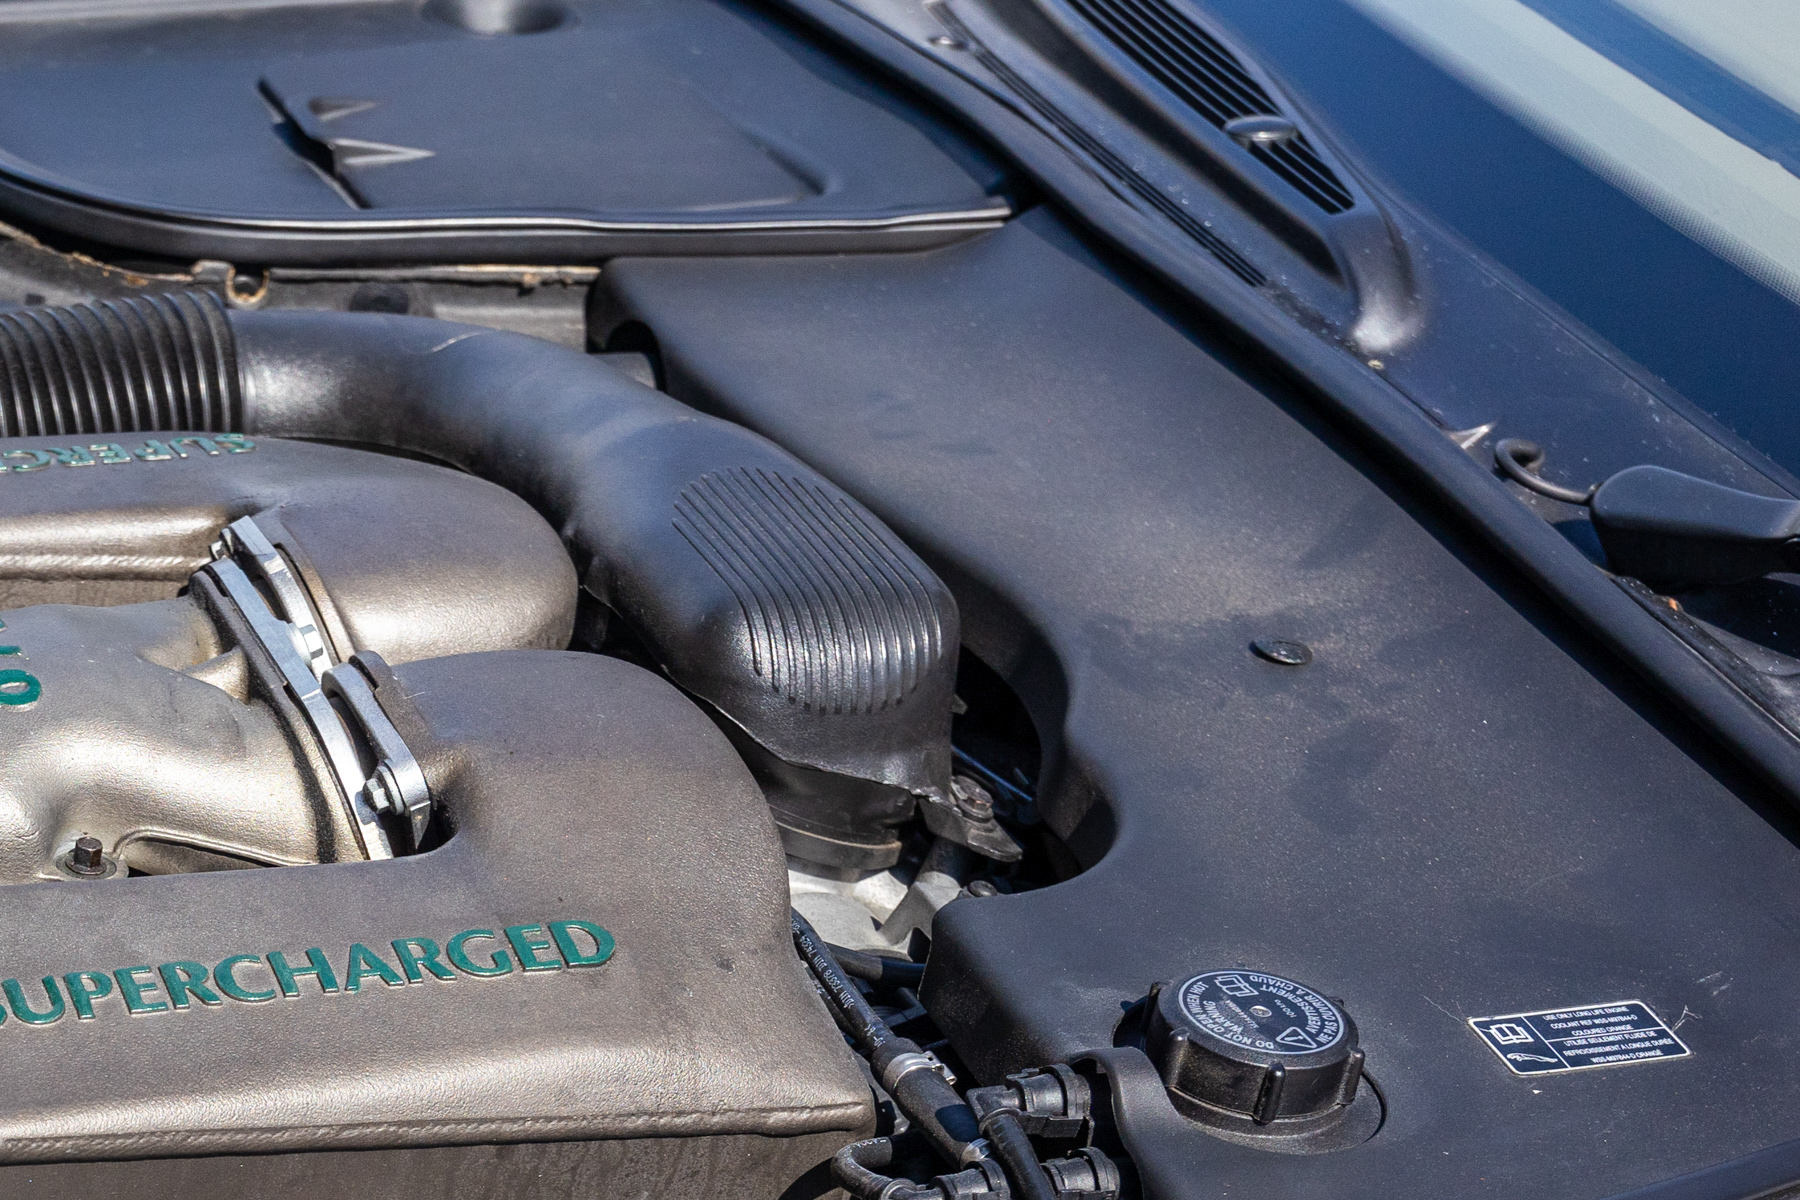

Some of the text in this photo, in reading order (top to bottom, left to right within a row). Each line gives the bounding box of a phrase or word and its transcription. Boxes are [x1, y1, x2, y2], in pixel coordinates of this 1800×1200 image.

[1250, 975, 1294, 991] CHAUD
[1187, 981, 1274, 1050] DO NOT OPEN WHEN HOT
[1260, 985, 1321, 1034] AVERTISSEMENT
[1305, 994, 1335, 1021] OUVRIR
[1542, 1013, 1556, 1021] USE
[1556, 1011, 1573, 1019] ONLY
[1573, 1009, 1592, 1018] LONG
[1202, 1001, 1244, 1034] WARNING
[1550, 1020, 1581, 1030] COOLANT
[1325, 1020, 1338, 1036] PAS
[1571, 1024, 1634, 1037] COLOURED ORANGE
[1315, 1032, 1333, 1044] NE
